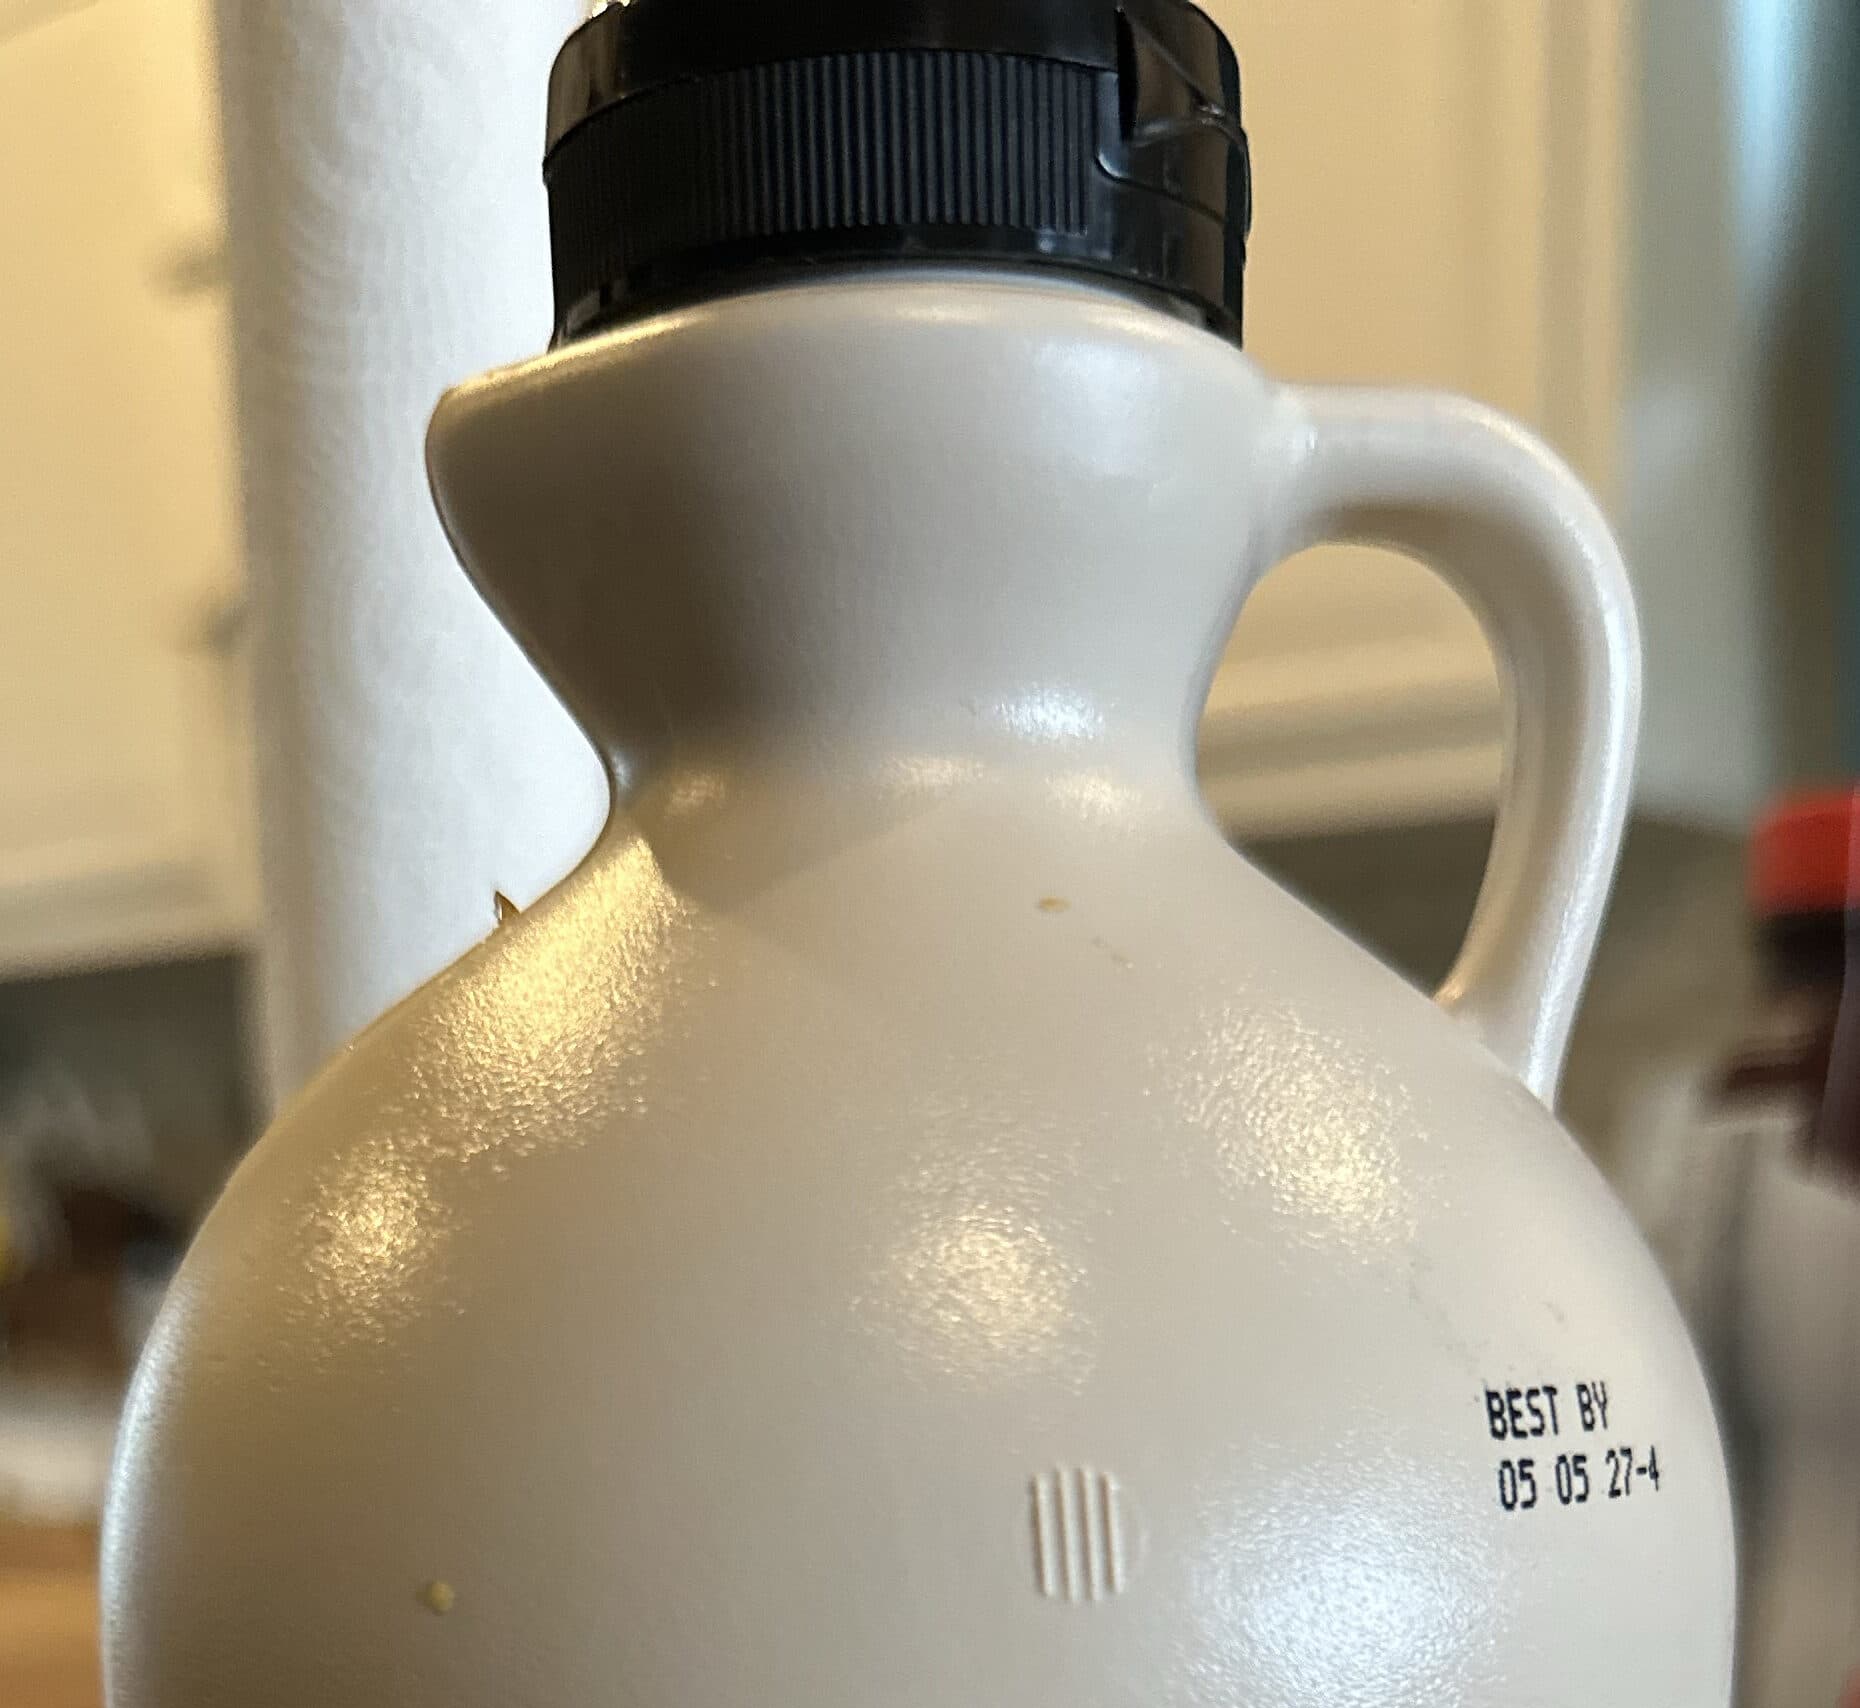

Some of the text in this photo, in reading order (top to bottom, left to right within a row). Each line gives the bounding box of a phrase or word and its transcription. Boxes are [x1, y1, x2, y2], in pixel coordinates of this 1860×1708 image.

[1485, 1381, 1608, 1440] BEST BY
[1499, 1445, 1660, 1511] 05 05 27-4
